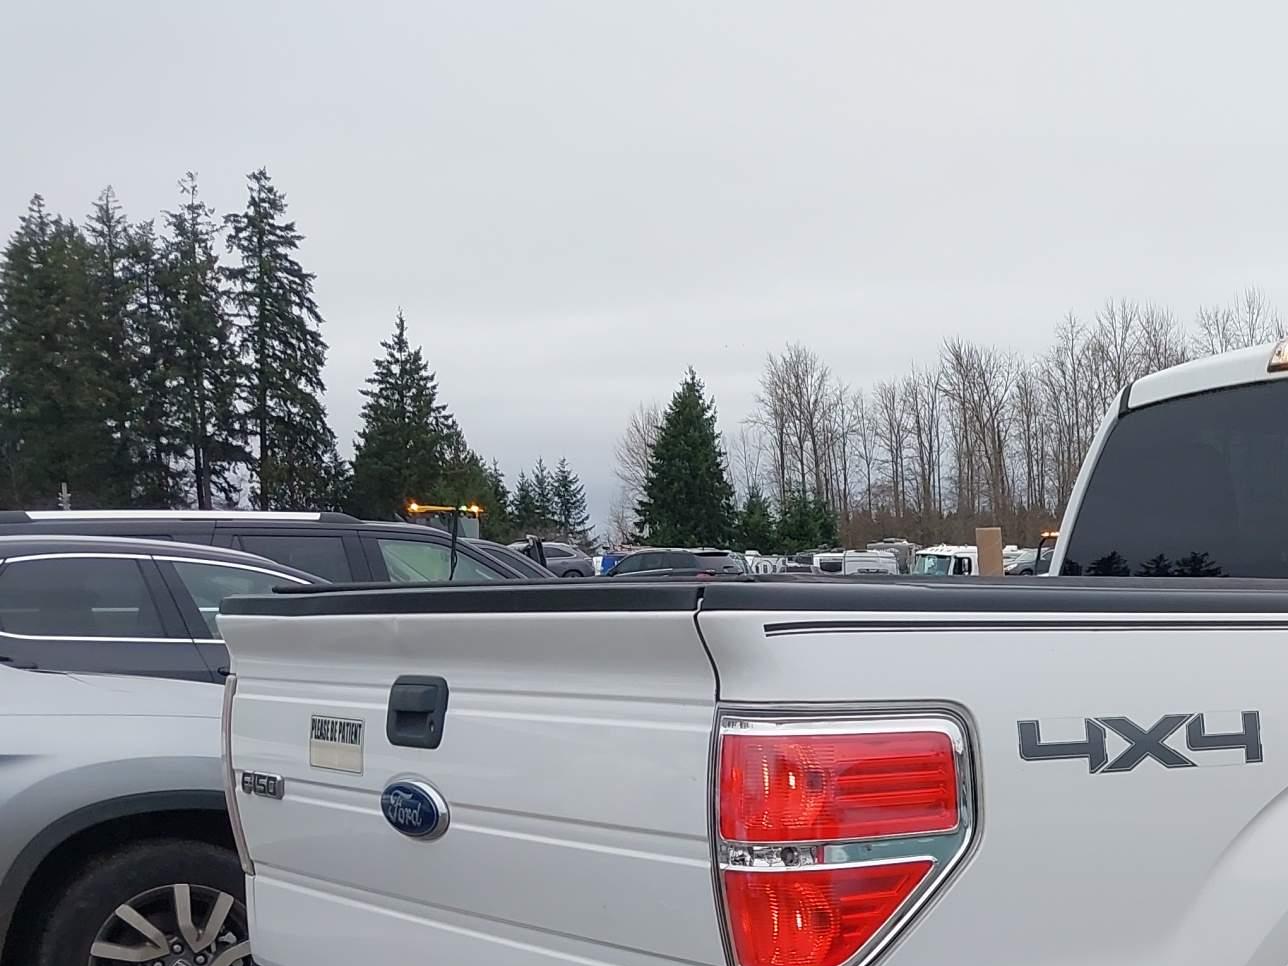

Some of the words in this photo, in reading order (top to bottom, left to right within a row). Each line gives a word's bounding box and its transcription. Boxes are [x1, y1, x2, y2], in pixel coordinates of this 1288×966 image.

[310, 718, 330, 742] PLEASE
[329, 719, 338, 743] BE
[337, 720, 362, 746] PATIENT
[388, 789, 423, 827] Ford
